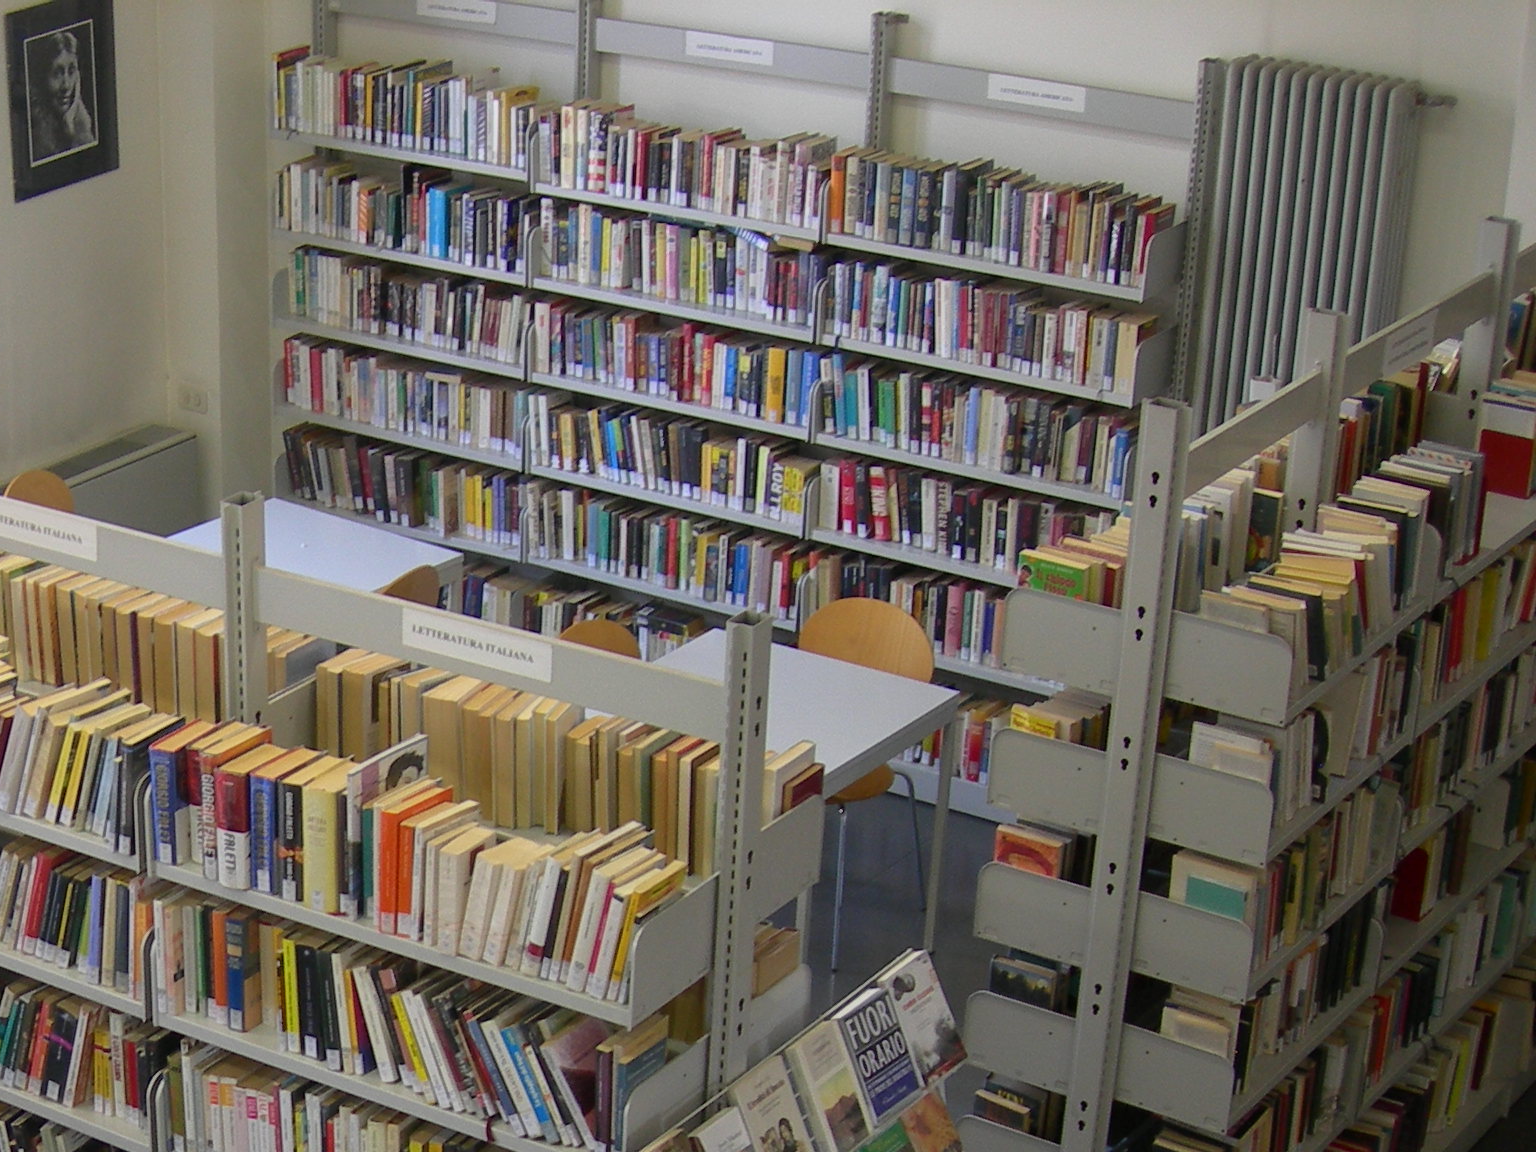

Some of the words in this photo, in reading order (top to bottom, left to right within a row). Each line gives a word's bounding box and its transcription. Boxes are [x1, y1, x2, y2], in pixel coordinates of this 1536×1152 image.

[43, 526, 83, 545] ITALIANA
[412, 624, 484, 652] LETTERATURA
[485, 643, 534, 664] ITALIANA
[846, 995, 897, 1050] FUORI
[858, 1030, 907, 1079] ORARIO
